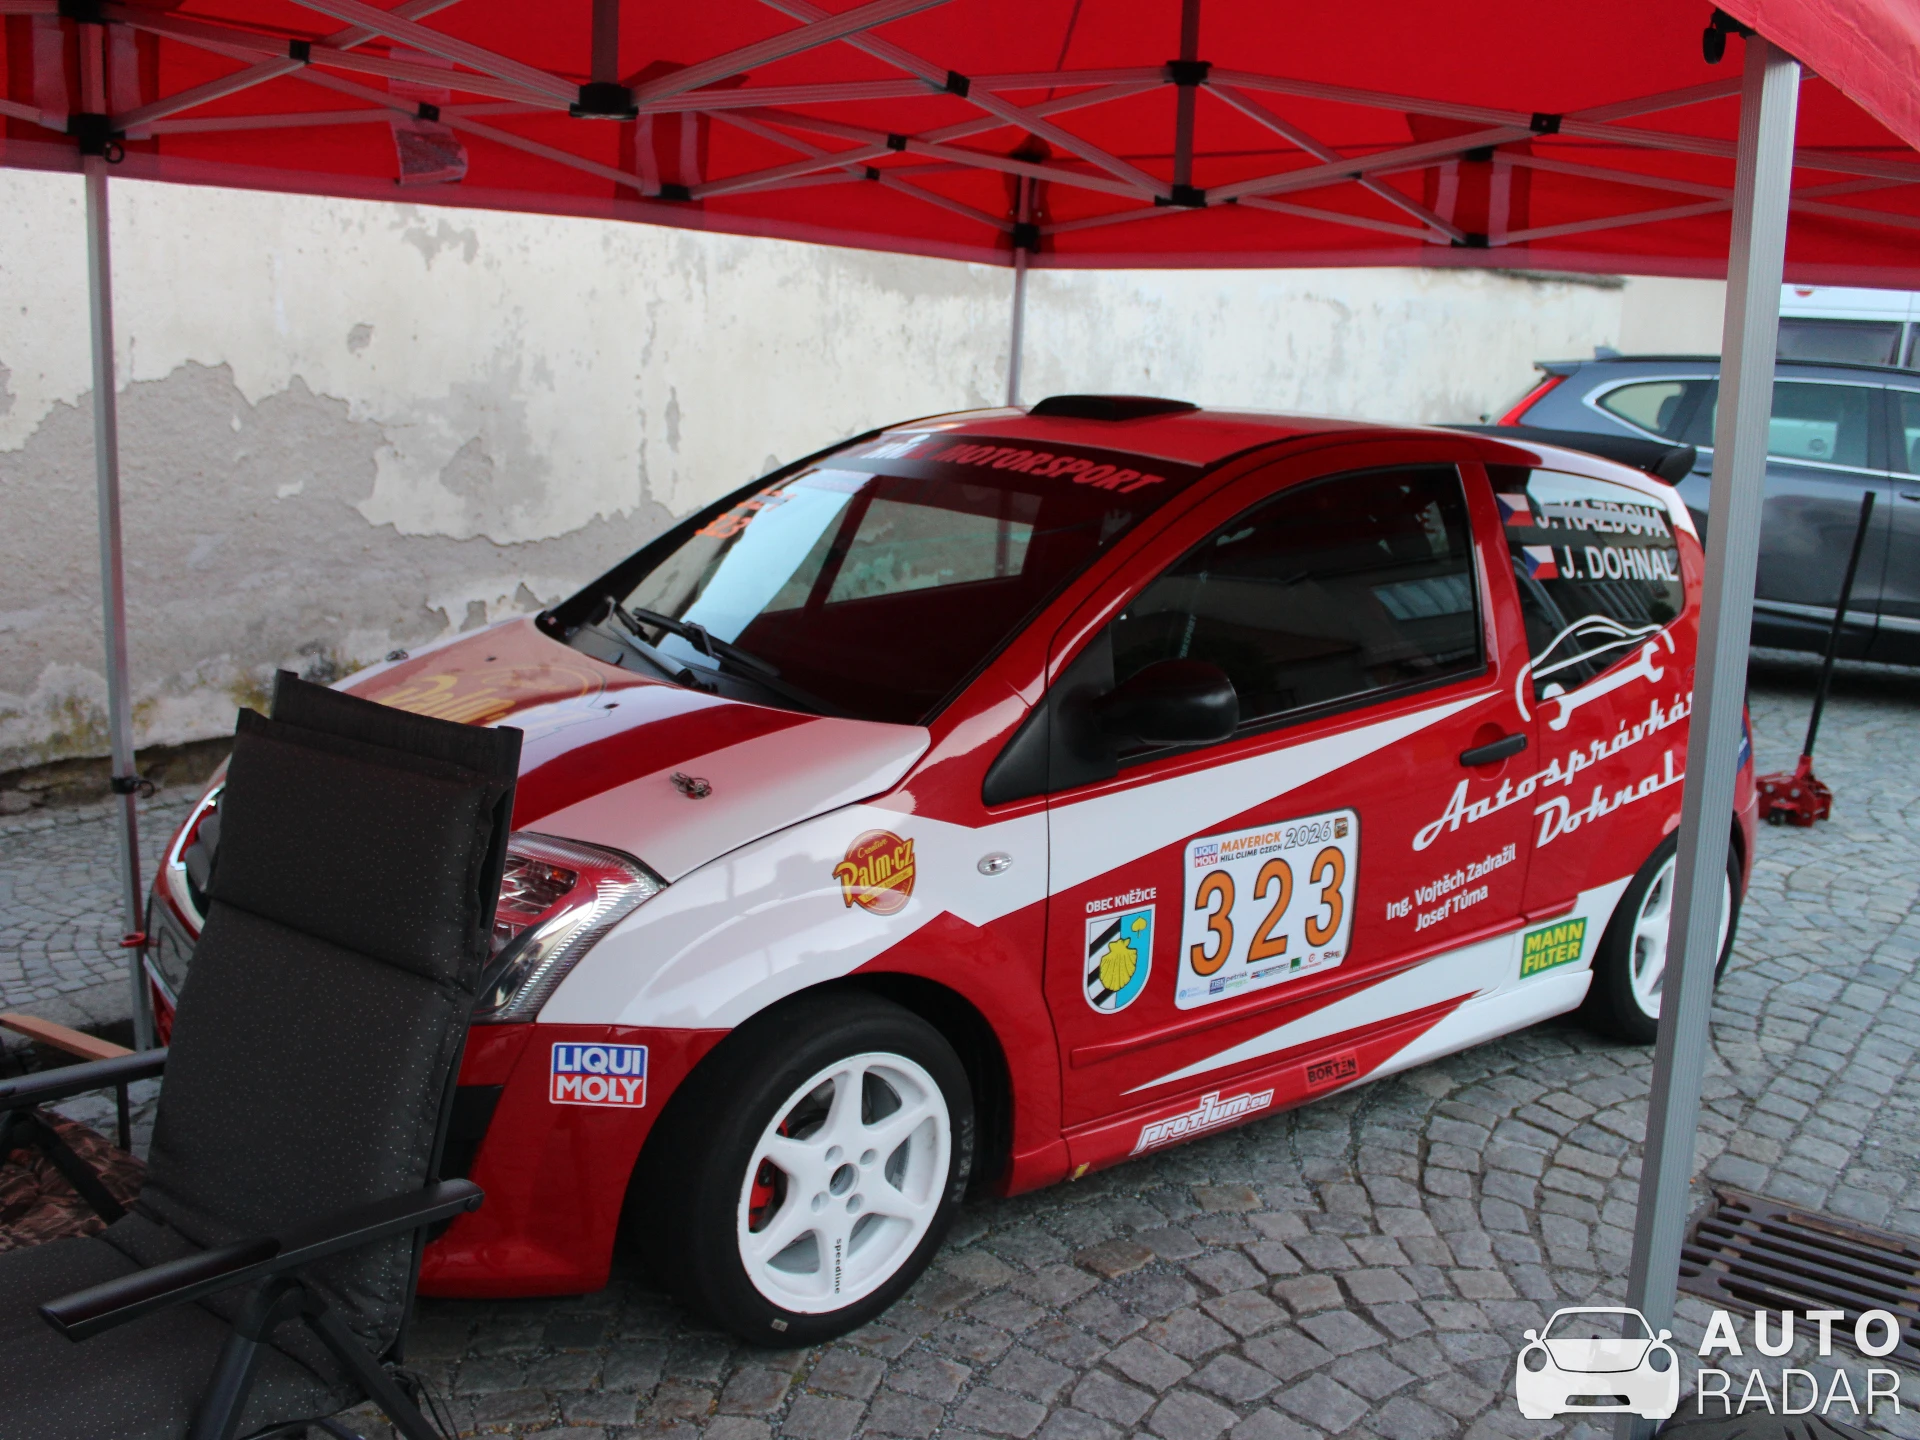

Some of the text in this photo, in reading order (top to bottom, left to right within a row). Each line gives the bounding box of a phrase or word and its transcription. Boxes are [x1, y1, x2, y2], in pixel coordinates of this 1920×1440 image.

[931, 443, 1166, 494] MOTORSPORT
[1561, 544, 1679, 581] J. DOHNAL
[1534, 750, 1685, 848] Dohnal
[1194, 844, 1218, 856] LIQUI
[1220, 844, 1282, 863] HILL CLIMB CZECH
[1221, 821, 1332, 854] MAVERICK 2026
[1195, 854, 1218, 867] MOLY
[1386, 843, 1516, 920] Ing. Vojtěch Zadražil
[1086, 887, 1156, 913] OBEC KNĚŽICE
[1190, 846, 1346, 977] 323
[1415, 885, 1489, 932] Josef Tůma
[1526, 922, 1584, 955] MANN
[1524, 941, 1581, 974] FILTER
[557, 1047, 642, 1075] LIQUI
[1308, 1058, 1356, 1083] BORTEN
[556, 1075, 643, 1103] MOLY
[834, 1238, 842, 1295] speedline
